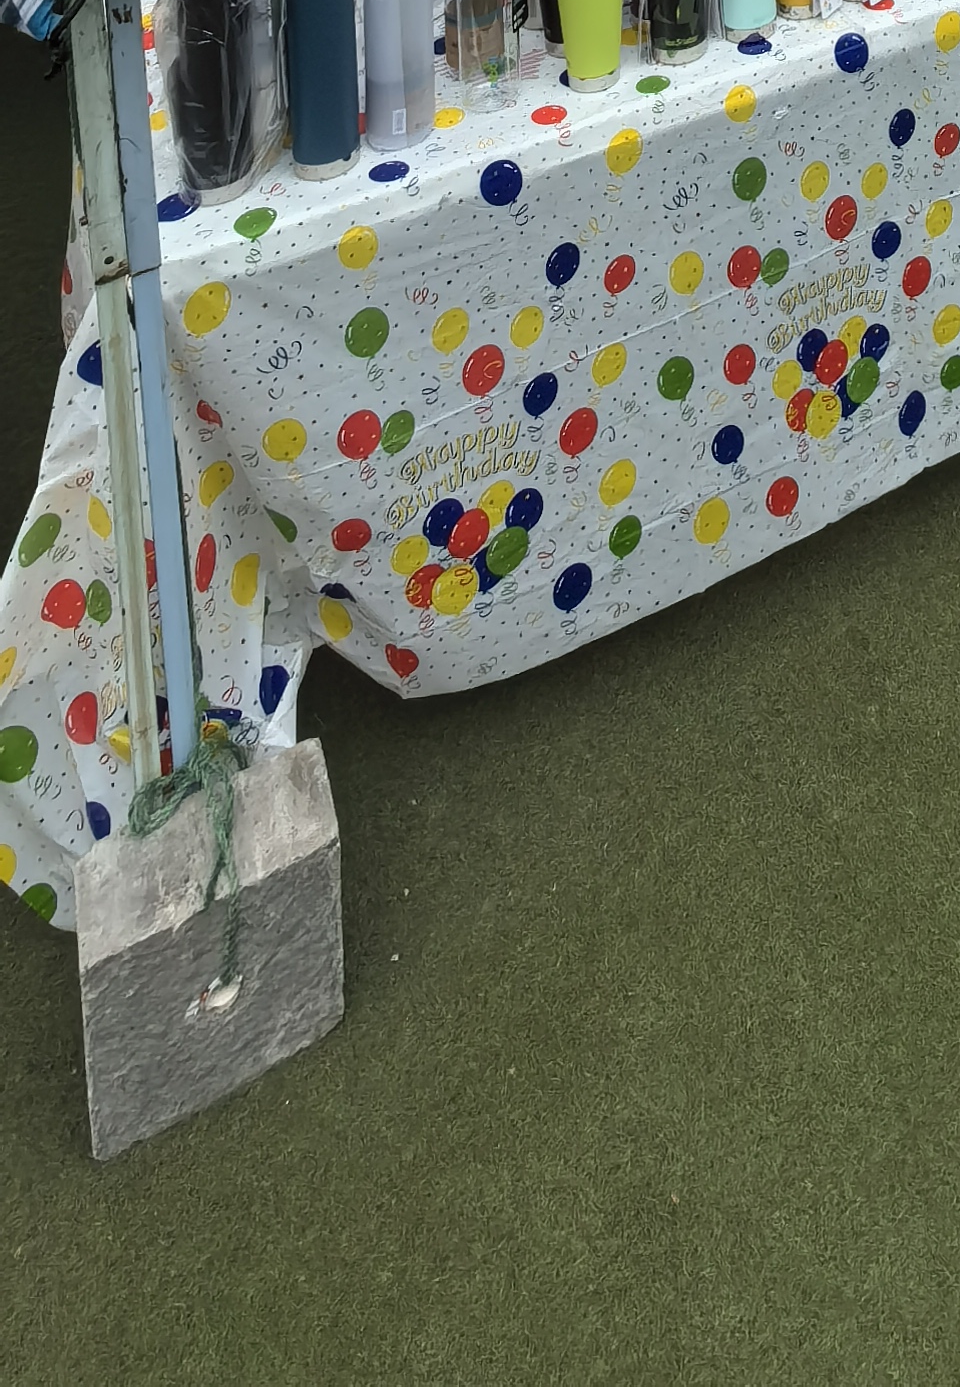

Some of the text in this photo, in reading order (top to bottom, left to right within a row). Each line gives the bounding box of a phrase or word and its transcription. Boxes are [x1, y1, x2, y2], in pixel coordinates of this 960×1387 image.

[766, 285, 887, 354] Birthday
[778, 263, 871, 315] Happy
[400, 420, 521, 485] Happy
[385, 448, 541, 529] Birthday
